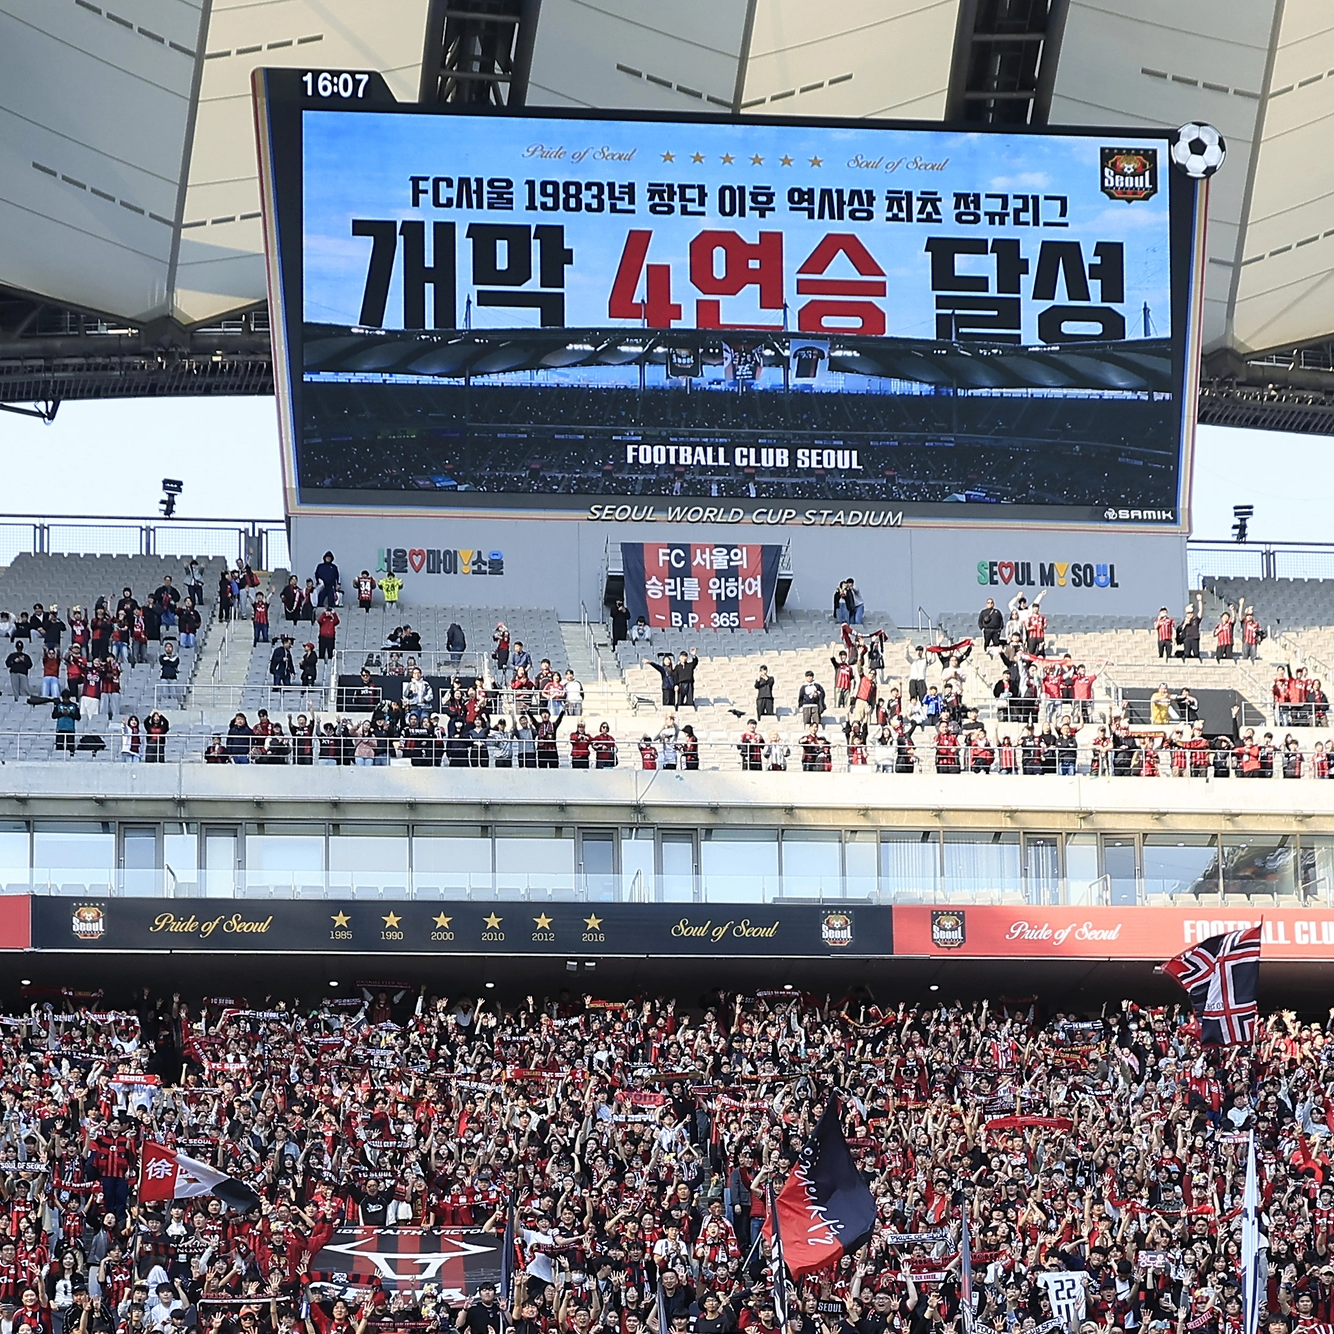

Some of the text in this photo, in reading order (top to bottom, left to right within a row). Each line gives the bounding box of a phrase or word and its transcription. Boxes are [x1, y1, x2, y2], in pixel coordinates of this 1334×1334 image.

[301, 72, 370, 98] 16:07
[522, 144, 637, 164] Pride of Seoul
[847, 153, 950, 174] Soul of Seoul
[409, 176, 1070, 228] FC서울 1983년 창단 이후 역사상 최초 정규리그
[352, 219, 1126, 345] 개막 4연승 달성
[626, 444, 864, 471] FOOTBALL CLUB SEOUL
[586, 503, 905, 528] SEOUL WORLD CUP STADIUM
[1118, 508, 1173, 520] SAMIK
[658, 546, 748, 570] FC 서울의
[644, 575, 763, 601] 승리를 위하여
[710, 612, 741, 628] 365
[149, 912, 272, 939] Pride of Seoul
[329, 930, 606, 941] 1985 1990 2000 2010 2012 2016
[670, 918, 779, 943] Soul of Seoul
[1005, 921, 1121, 948] Pride of Seoul
[146, 1157, 174, 1181] 徐
[1054, 1279, 1076, 1301] 22
